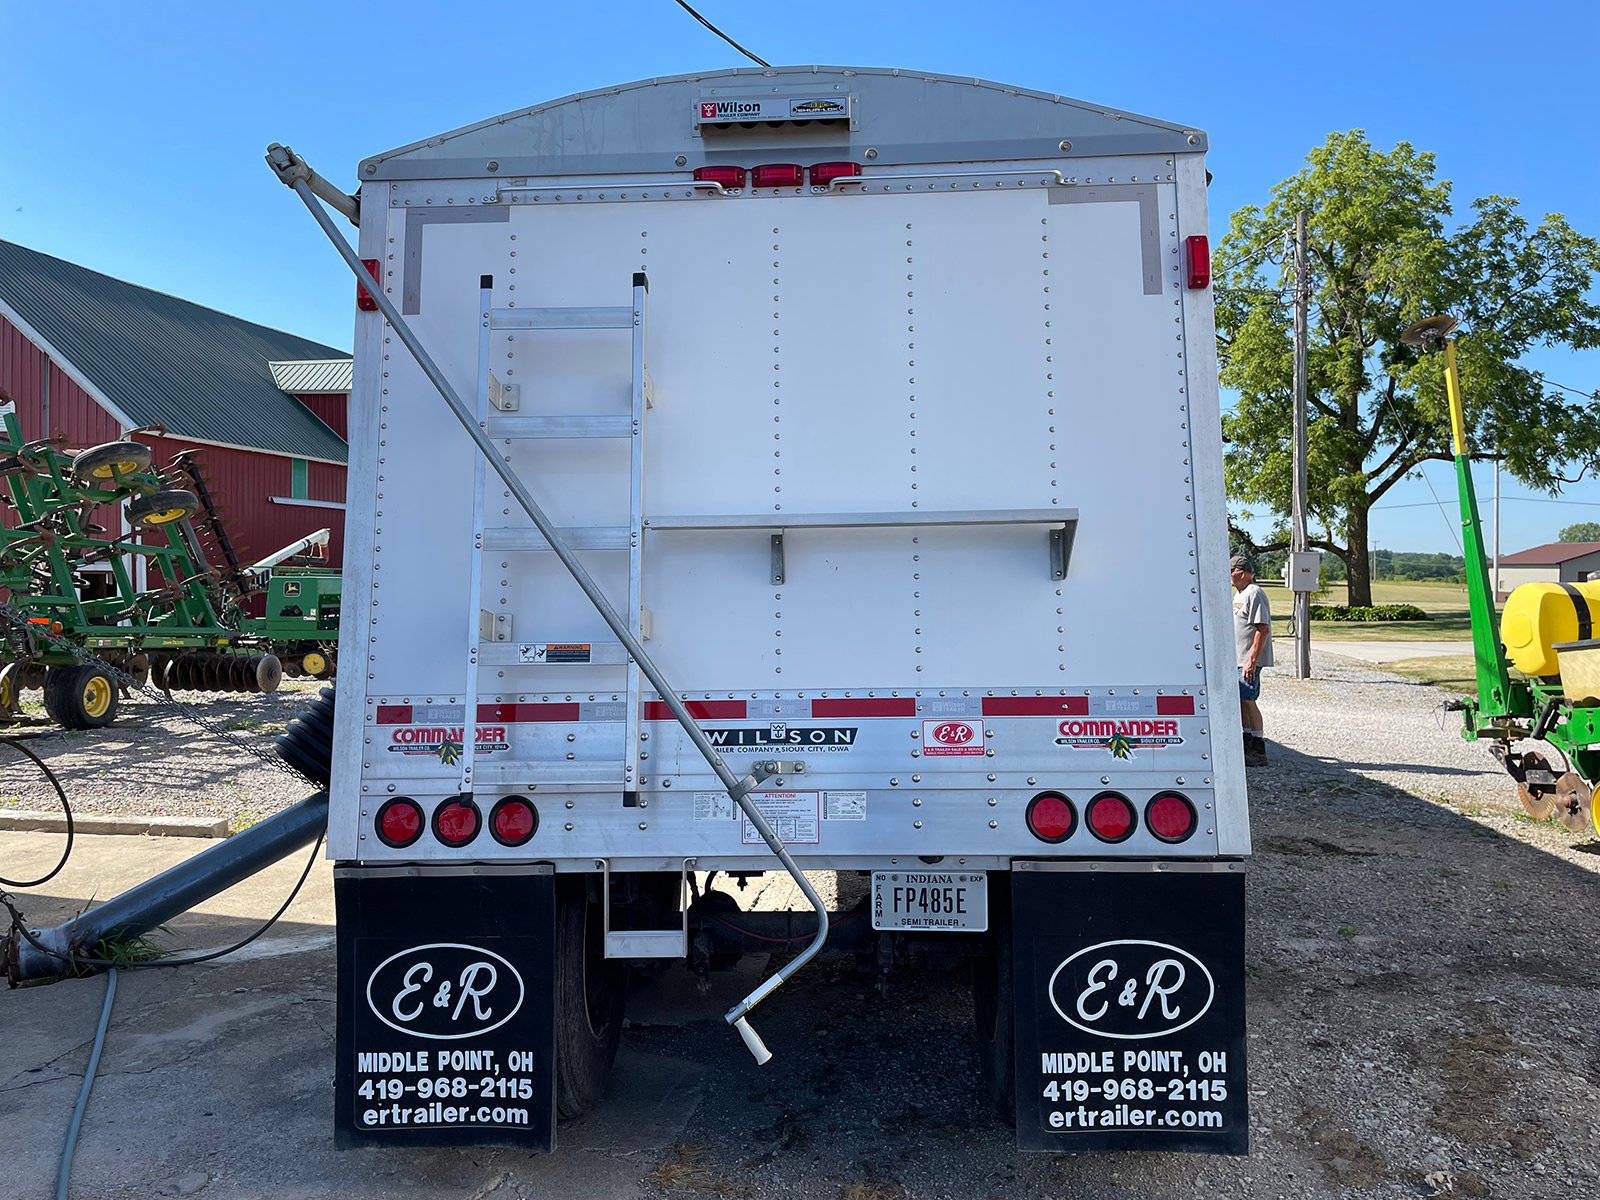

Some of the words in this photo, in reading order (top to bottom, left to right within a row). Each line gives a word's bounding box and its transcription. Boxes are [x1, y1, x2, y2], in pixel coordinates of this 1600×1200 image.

[716, 101, 761, 113] Wilson
[704, 729, 851, 744] WILSON
[1059, 720, 1179, 736] COMMANDER
[905, 875, 953, 884] INDIANA
[893, 887, 967, 914] FP485E
[901, 918, 921, 926] SEMI
[923, 918, 959, 926] TRAILER
[358, 1051, 429, 1073] MIDDLE
[438, 1050, 500, 1076] POINT,
[508, 1051, 533, 1072] OH
[1042, 1051, 1114, 1074] MIDDLE
[1123, 1050, 1189, 1078] POINT,
[1198, 1051, 1227, 1073] OH
[358, 1077, 533, 1100] 419-968-2115
[1043, 1078, 1228, 1101] 419-968-2115
[363, 1102, 529, 1125] ertrailer.com
[1049, 1104, 1223, 1128] ertrailer.com
